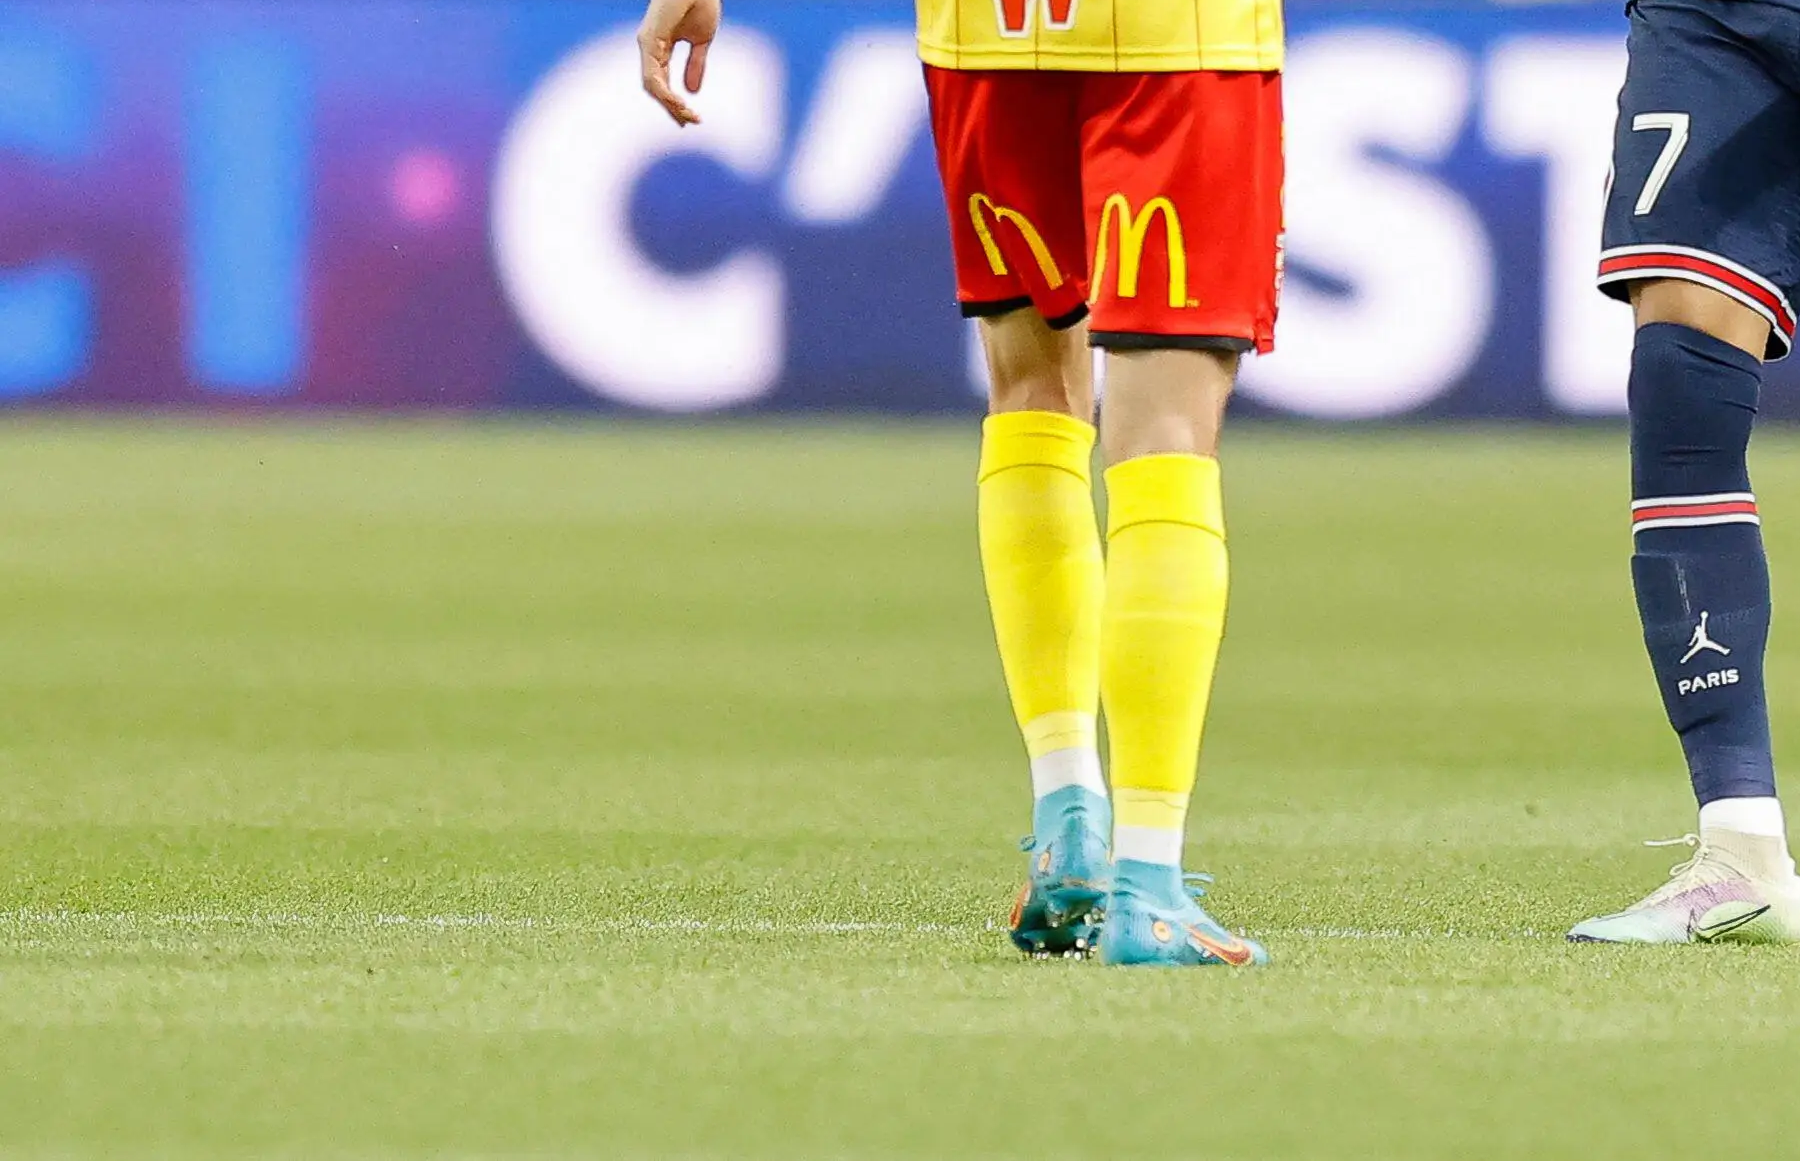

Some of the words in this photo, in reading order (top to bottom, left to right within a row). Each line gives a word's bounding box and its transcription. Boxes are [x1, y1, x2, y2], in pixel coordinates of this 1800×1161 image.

[1631, 112, 1691, 217] 7
[488, 21, 1632, 421] C'ST
[1678, 668, 1740, 696] PARIS
